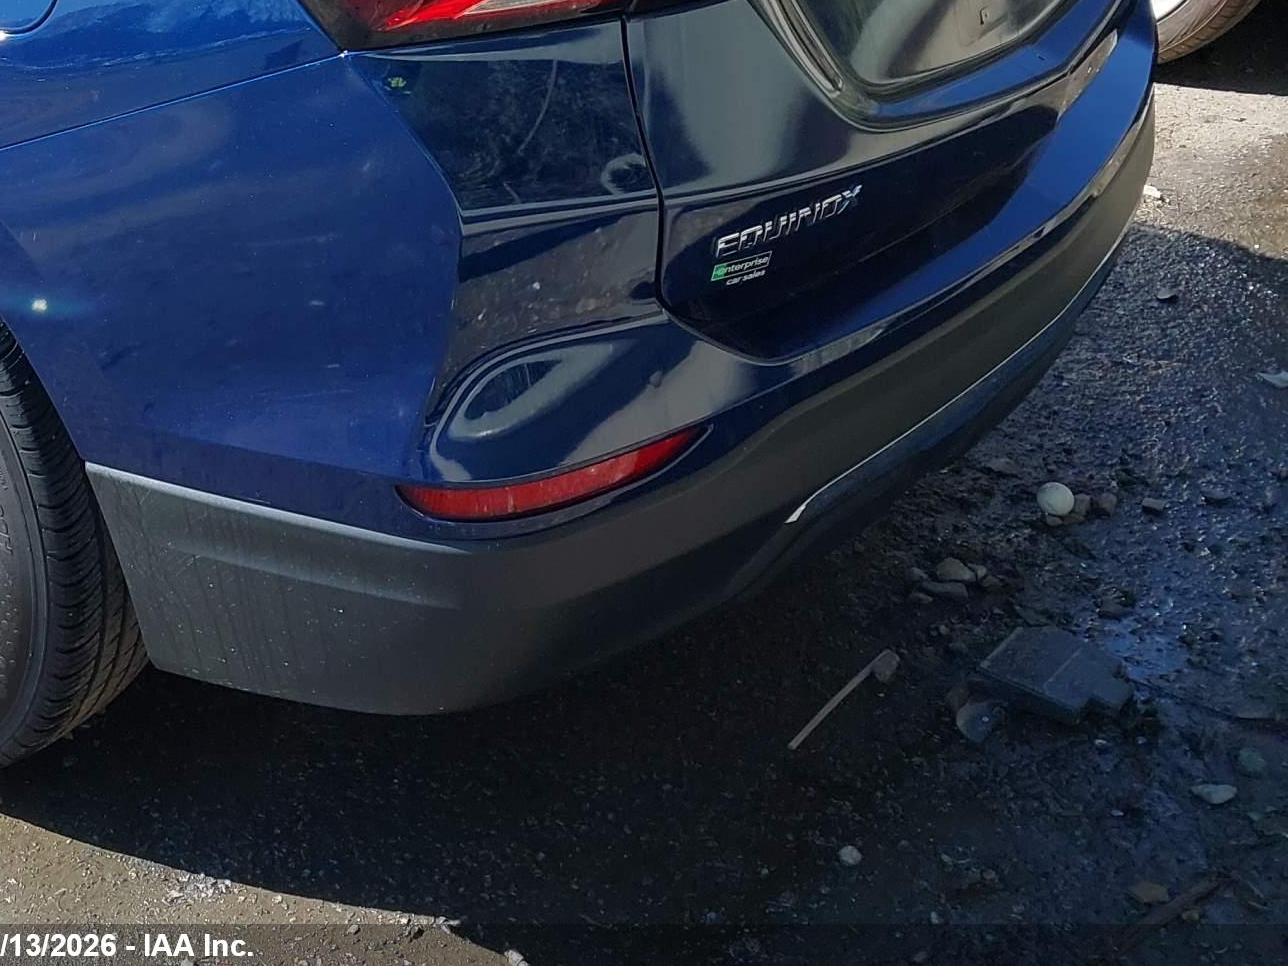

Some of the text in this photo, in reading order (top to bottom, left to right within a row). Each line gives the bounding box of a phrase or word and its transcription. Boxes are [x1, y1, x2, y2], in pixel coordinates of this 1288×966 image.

[715, 184, 863, 258] EQUINOX
[716, 256, 769, 276] enterprise
[726, 269, 766, 285] car sales
